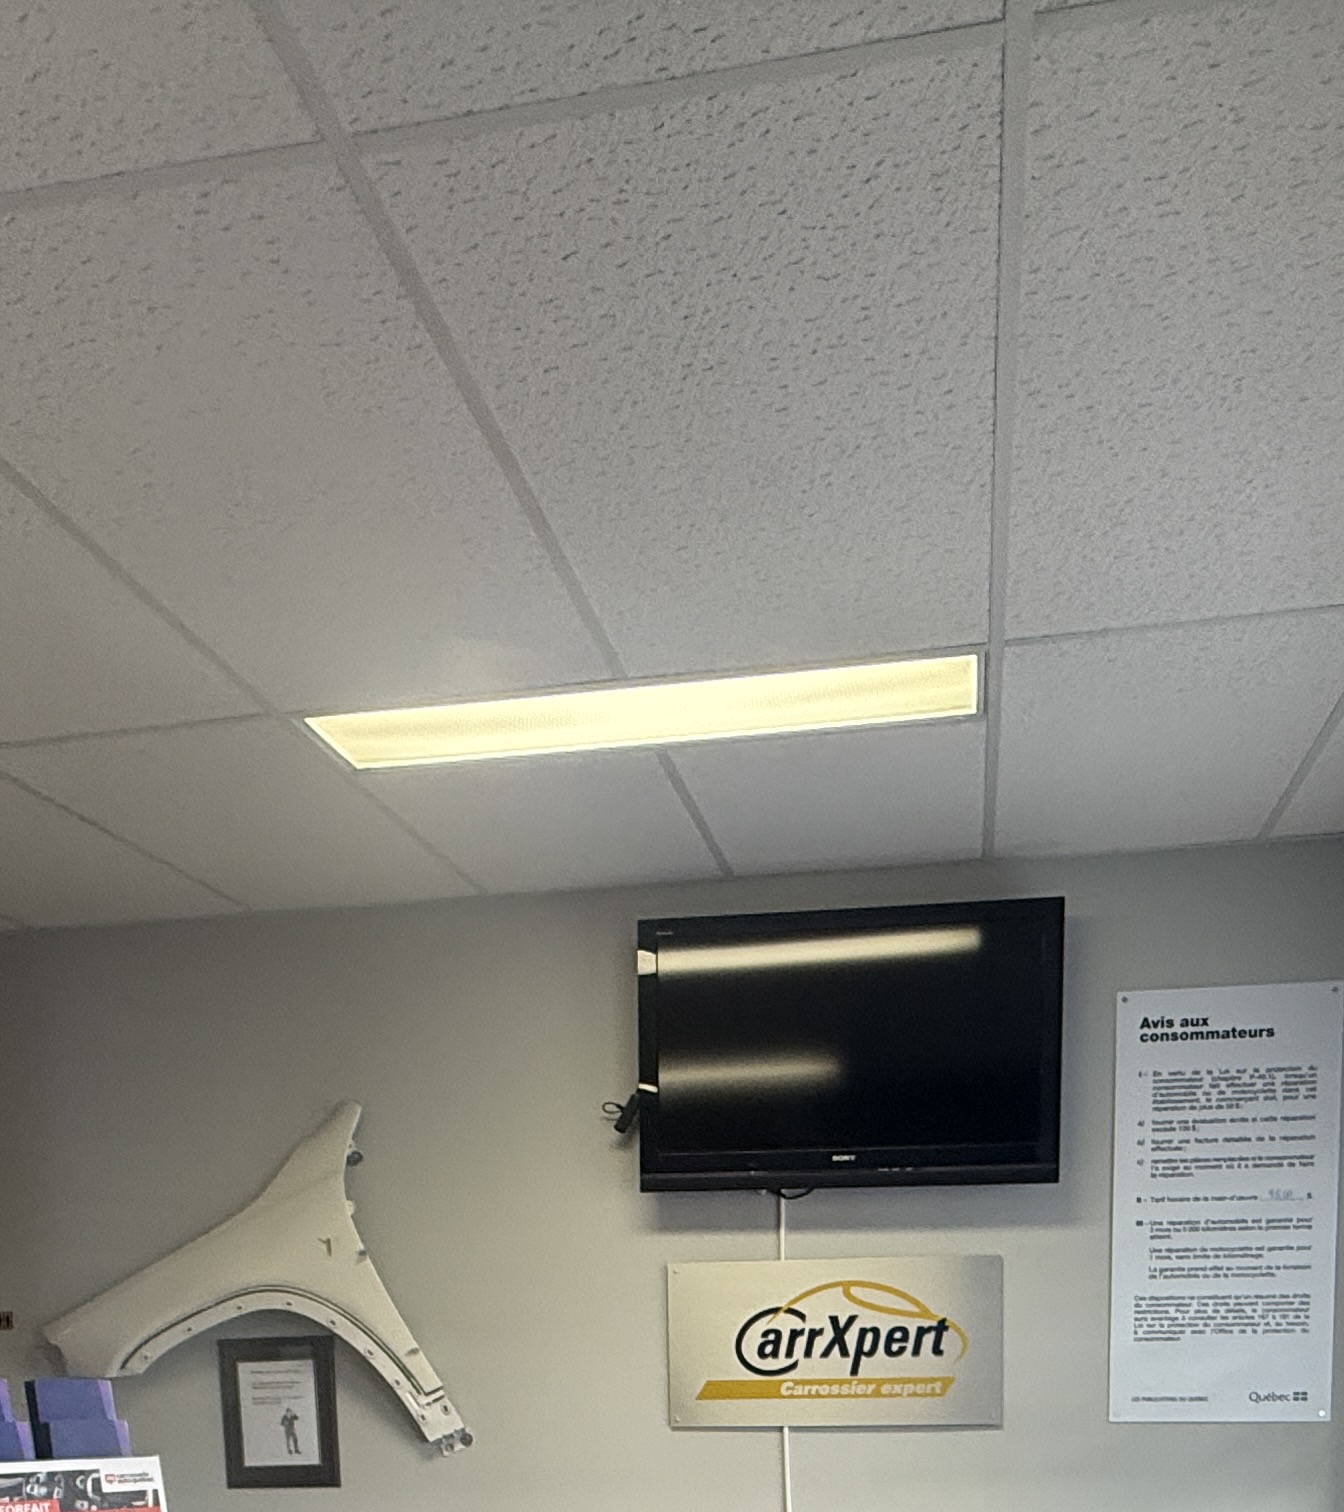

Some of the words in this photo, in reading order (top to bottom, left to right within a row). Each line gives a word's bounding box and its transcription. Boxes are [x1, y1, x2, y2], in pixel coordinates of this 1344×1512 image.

[1139, 1016, 1175, 1030] Avis
[1179, 1016, 1210, 1028] aux
[1139, 1026, 1275, 1043] consommateurs
[735, 1307, 949, 1377] CarrXpert
[780, 1381, 876, 1396] Carrossier
[880, 1380, 942, 1398] expert
[1248, 1391, 1291, 1404] Québec
